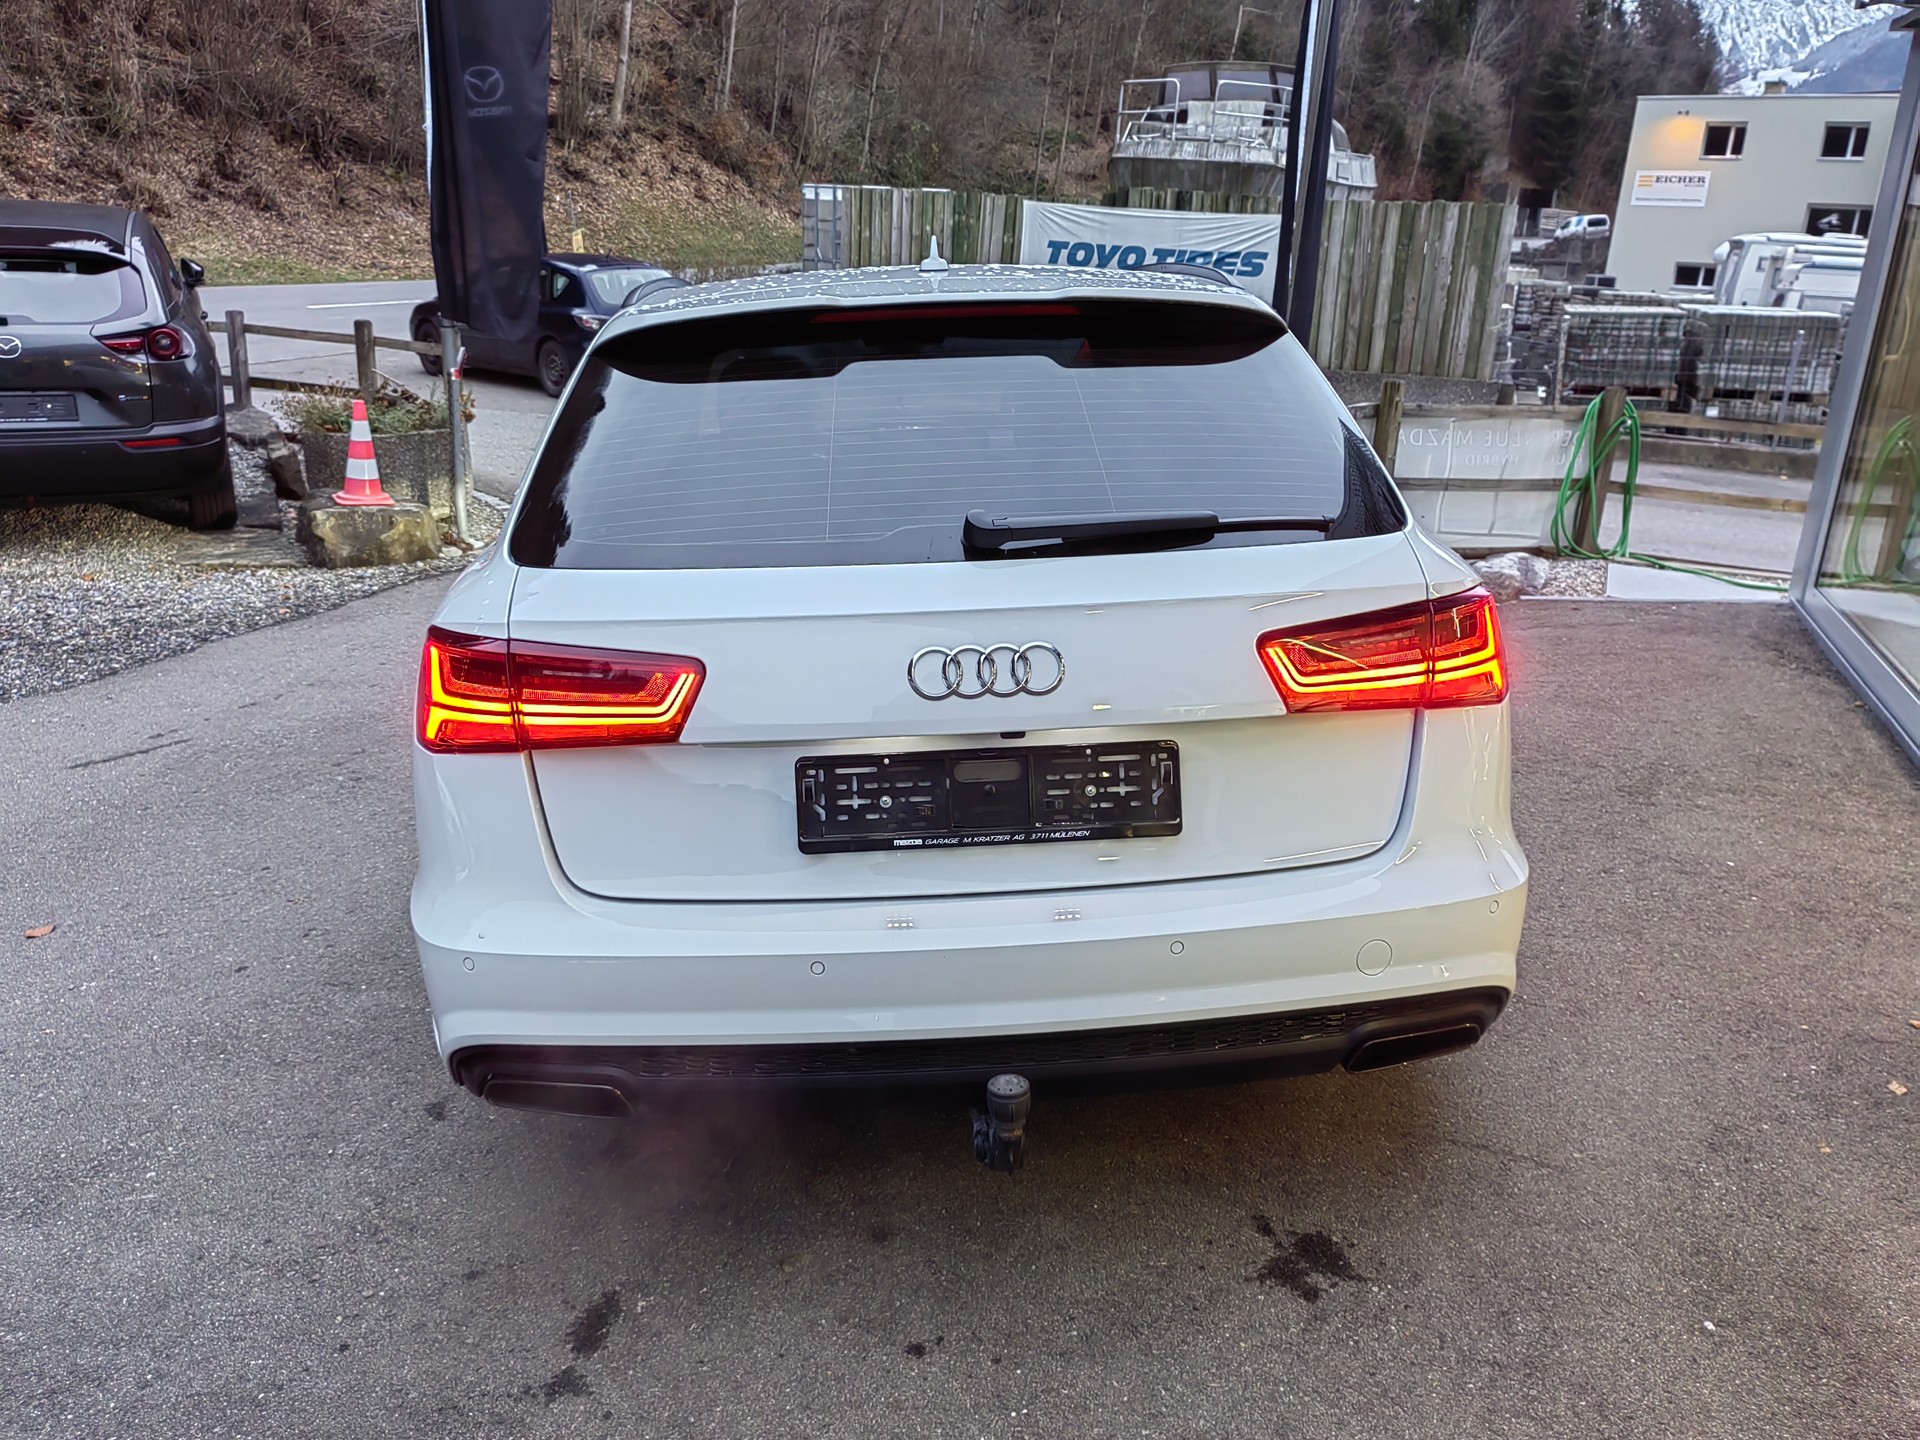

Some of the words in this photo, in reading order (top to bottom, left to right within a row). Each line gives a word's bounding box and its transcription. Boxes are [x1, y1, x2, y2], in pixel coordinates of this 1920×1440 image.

[1655, 175, 1706, 184] EICHER
[1047, 240, 1147, 270] TOYO
[1152, 248, 1269, 277] TIRES
[925, 837, 960, 845] GARAGE
[973, 834, 1011, 843] KRATZER
[1012, 833, 1025, 841] AG
[1030, 832, 1050, 840] 3711
[1050, 830, 1091, 839] MÜLENEN
